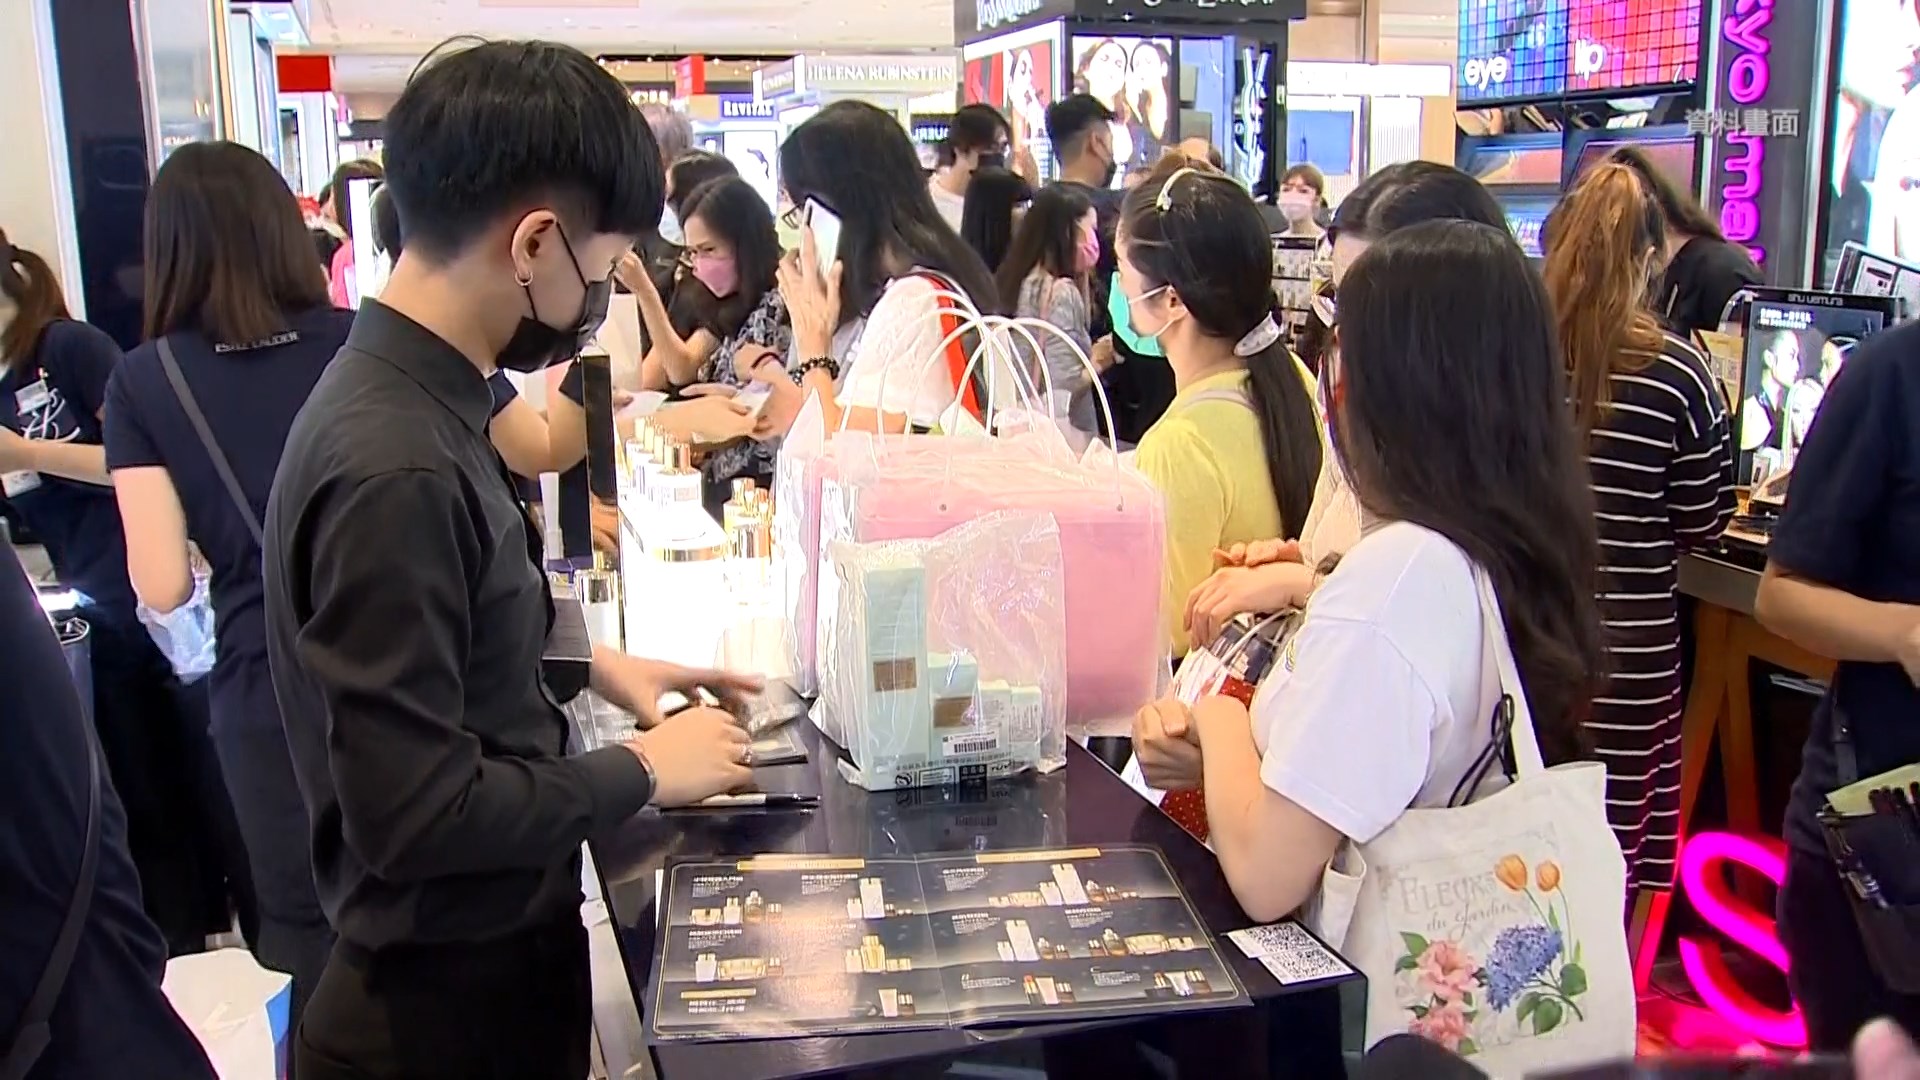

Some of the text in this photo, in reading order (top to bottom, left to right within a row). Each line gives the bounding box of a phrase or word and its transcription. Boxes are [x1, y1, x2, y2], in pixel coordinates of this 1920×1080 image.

[807, 64, 953, 81] HELENA RUBINSTEIN
[1573, 38, 1607, 81] lip
[1464, 56, 1508, 91] eye
[723, 100, 774, 117] REVITAL
